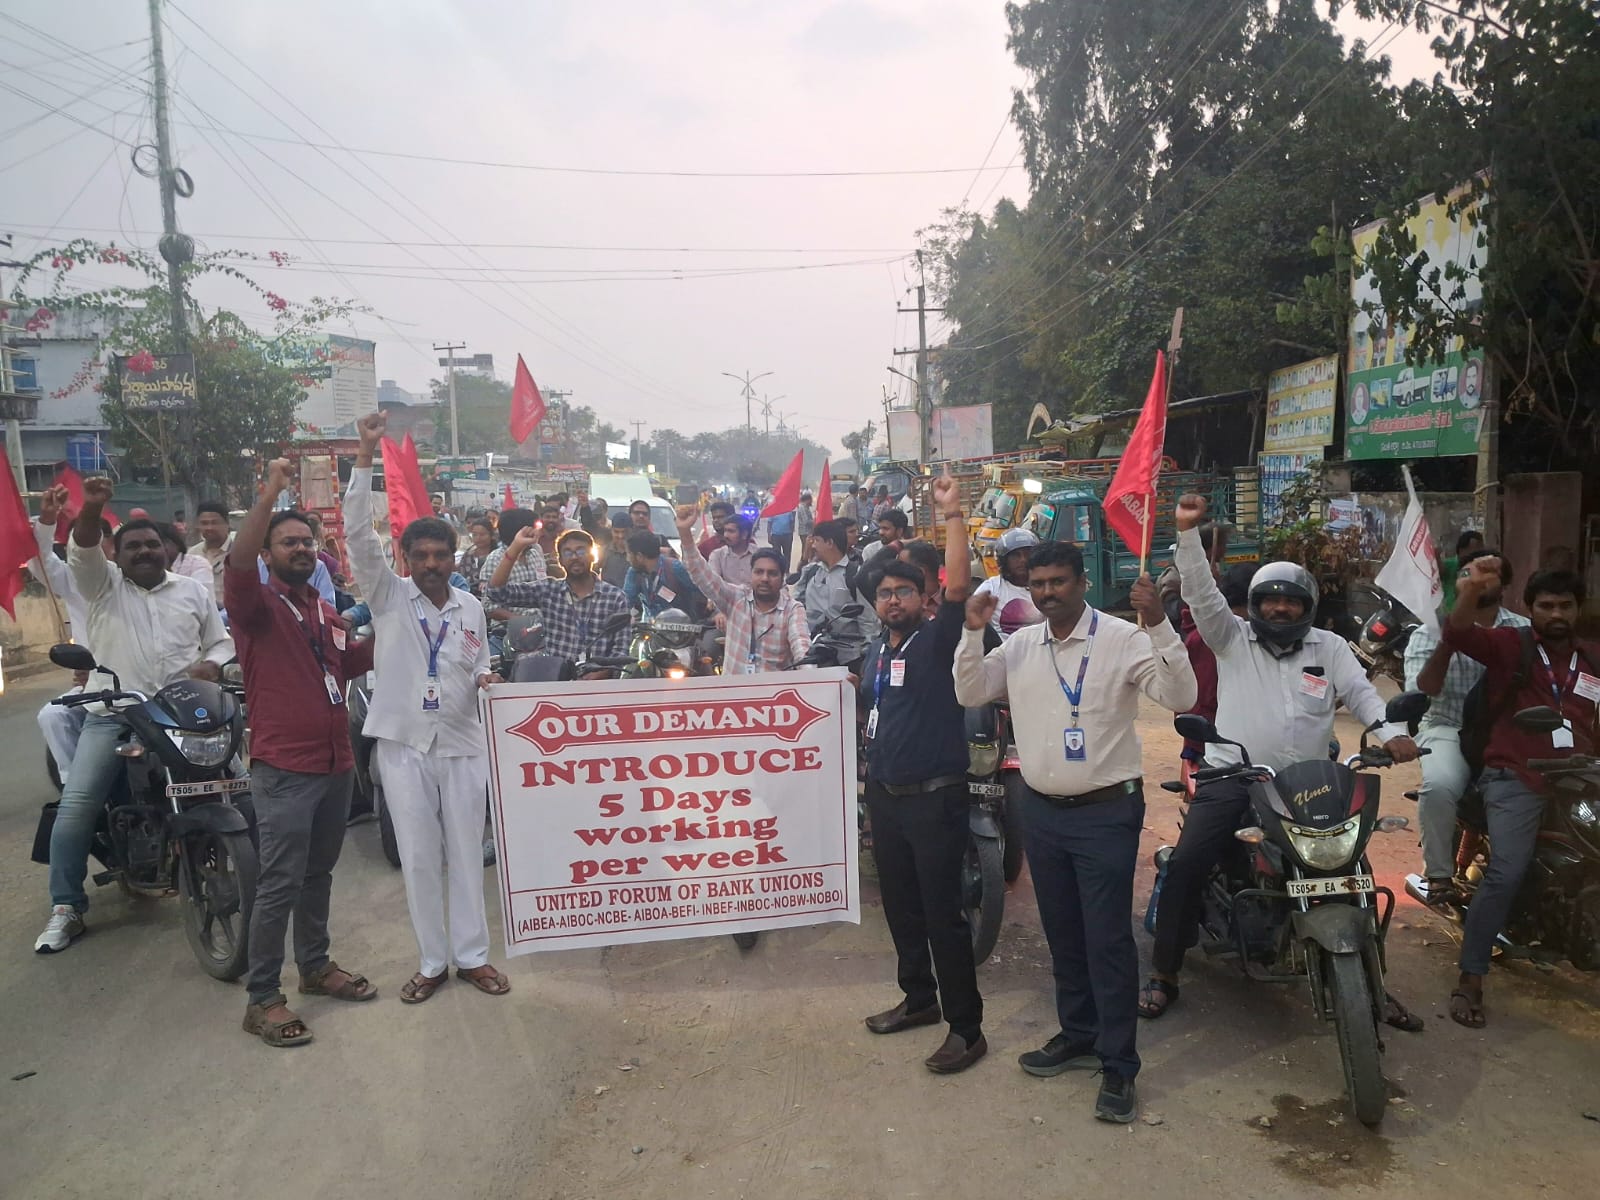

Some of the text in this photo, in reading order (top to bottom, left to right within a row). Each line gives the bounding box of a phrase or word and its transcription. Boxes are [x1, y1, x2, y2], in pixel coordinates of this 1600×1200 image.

[537, 704, 800, 739] OUR DEMAND
[519, 746, 822, 788] INTRODUCE
[171, 787, 193, 795] TS05
[599, 786, 752, 818] 5 Days
[574, 816, 779, 846] working
[569, 842, 787, 884] per week
[535, 872, 823, 912] UNITED FORUM OF BANK UNIONS
[1290, 879, 1371, 894] TS05 EA 520
